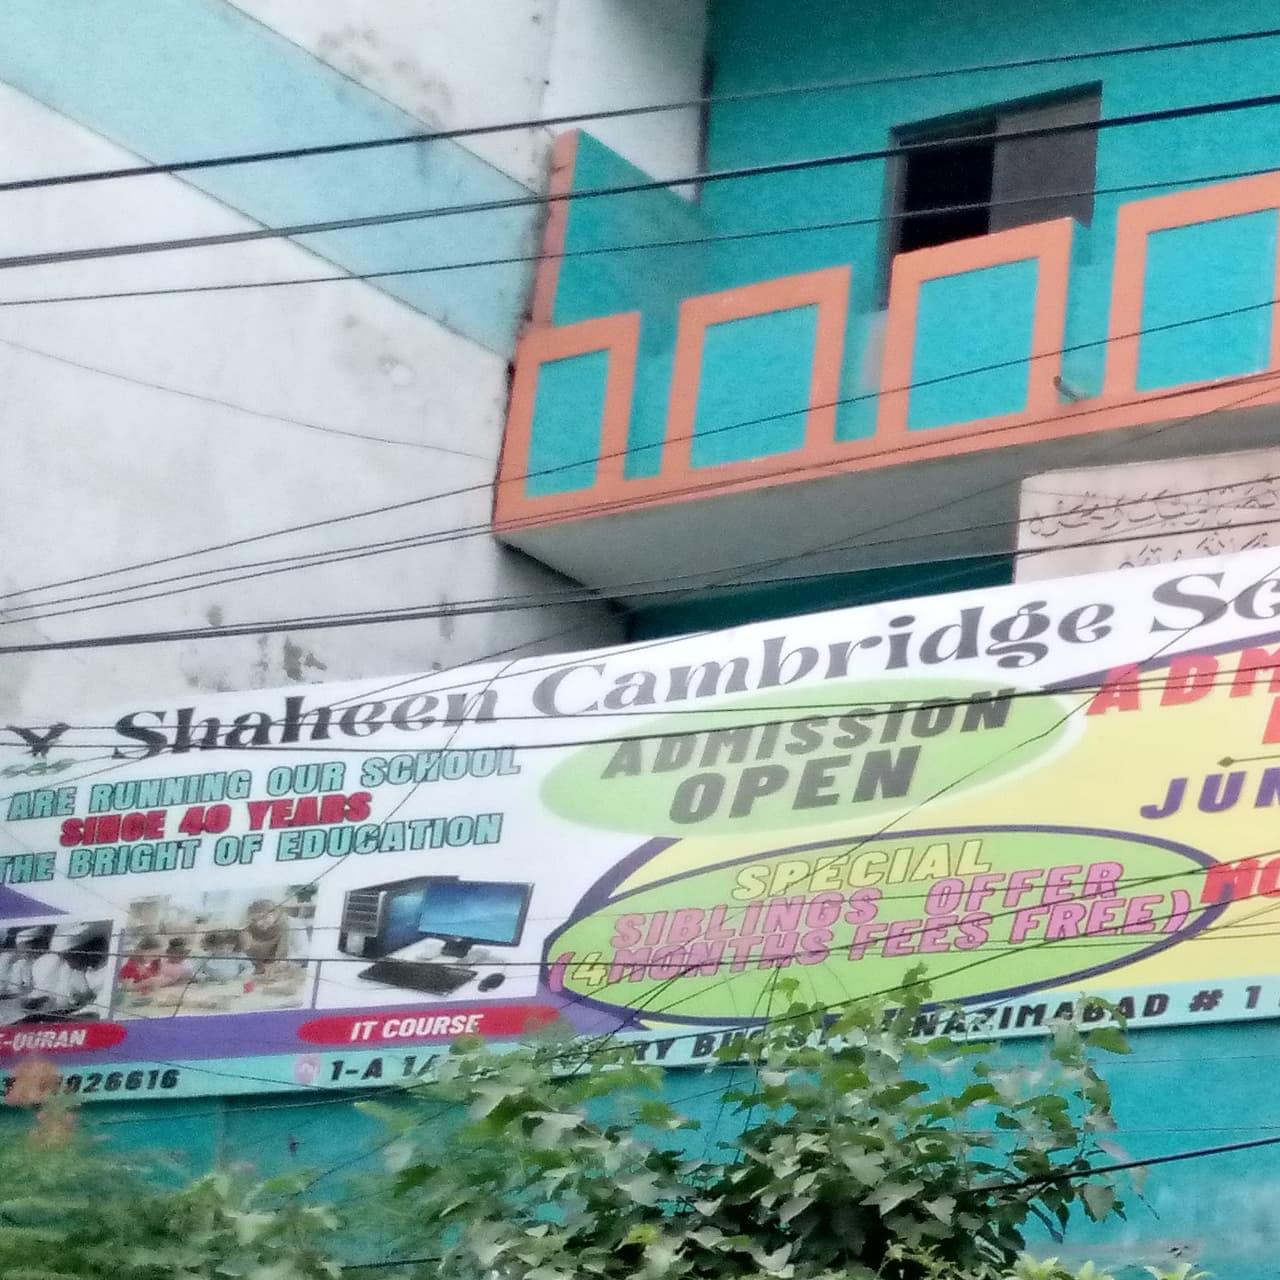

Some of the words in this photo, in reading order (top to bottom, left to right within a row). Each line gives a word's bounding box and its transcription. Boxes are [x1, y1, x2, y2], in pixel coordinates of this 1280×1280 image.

[111, 690, 499, 759] Shaheen
[531, 600, 1115, 717] Cambridge
[601, 686, 1018, 780] ADMISSION
[6, 785, 78, 822] ARE
[88, 769, 251, 814] RUNNING
[266, 761, 347, 797] OUR
[360, 748, 522, 789] SCHOOL
[59, 810, 168, 847] SINCE
[179, 804, 233, 837] 40
[247, 791, 373, 831] YEARS
[667, 744, 922, 825] OPEN
[67, 838, 202, 879] BRIGHT
[213, 833, 265, 867] OF
[275, 812, 504, 862] EDUCATION
[730, 838, 992, 901] SPECIAL
[607, 928, 835, 985] MONTHS
[847, 910, 994, 962] FEES
[1007, 889, 1193, 945] FREE)
[609, 886, 884, 949] SIBLINGS
[924, 861, 1125, 916] OFFER
[350, 1020, 374, 1042] IT
[381, 1013, 485, 1039] COURSE
[1244, 984, 1263, 1010] 1
